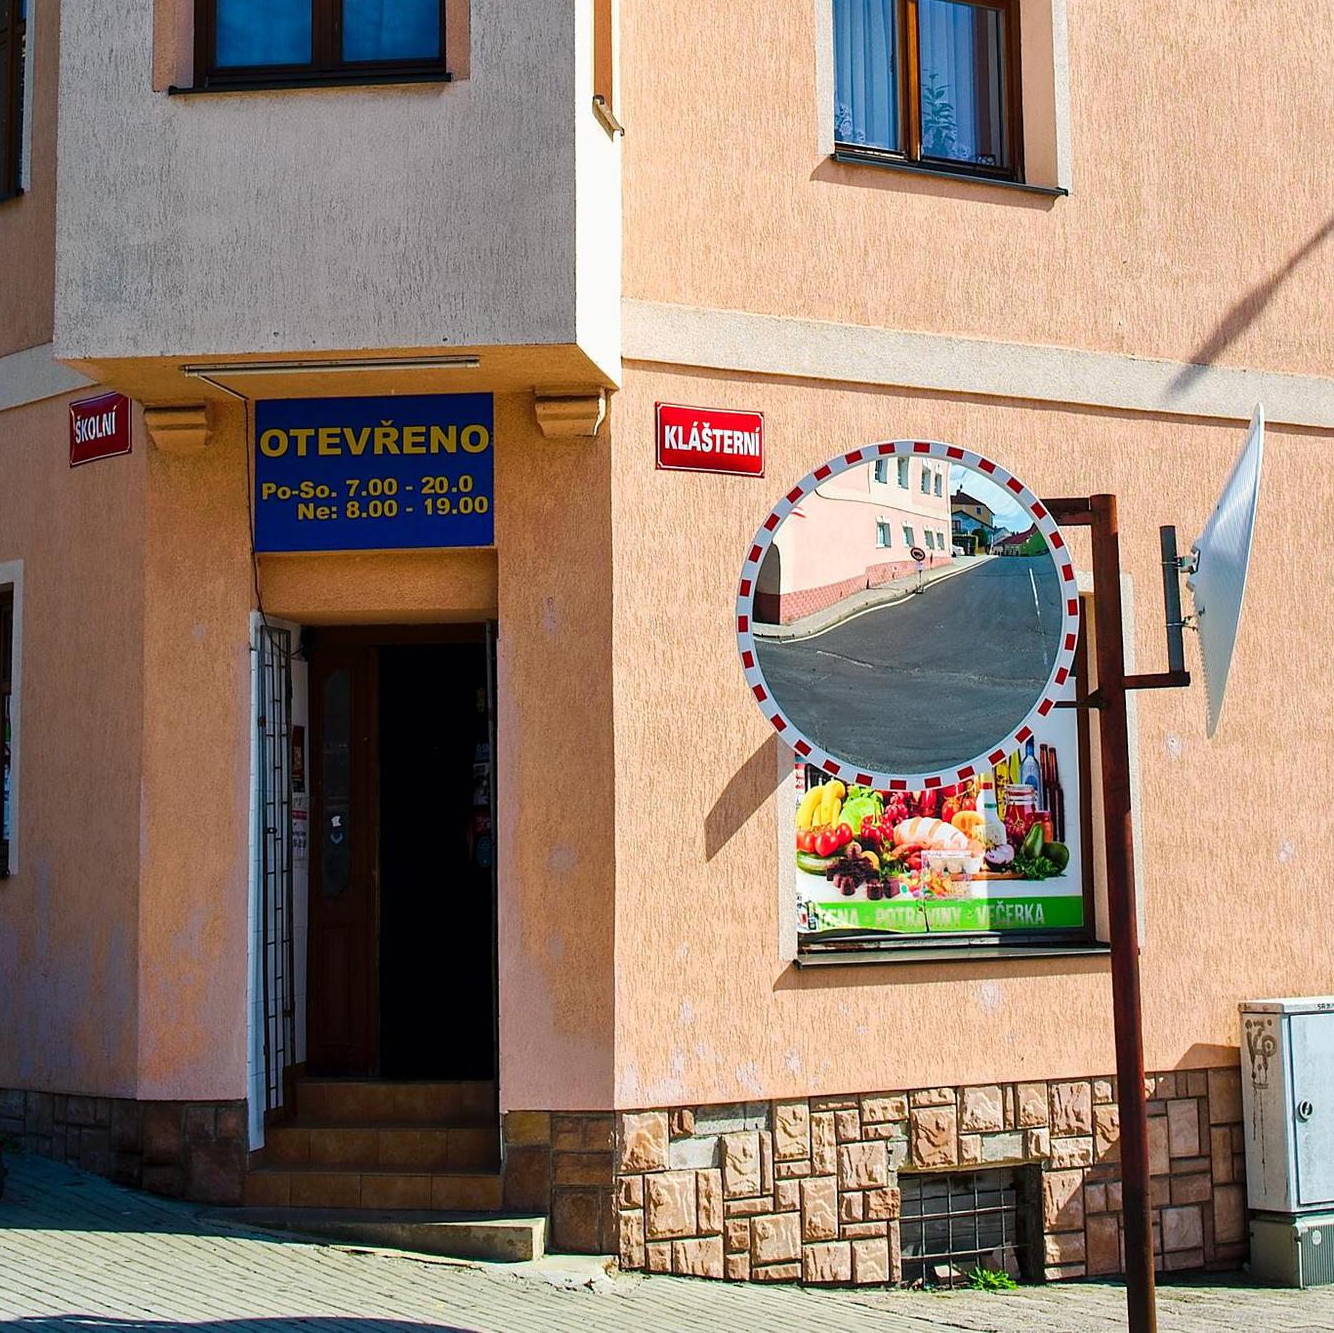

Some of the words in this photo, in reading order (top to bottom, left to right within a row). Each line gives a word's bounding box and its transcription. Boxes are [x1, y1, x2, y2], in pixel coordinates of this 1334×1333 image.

[75, 405, 117, 444] ŠKOLNÍ
[260, 420, 490, 457] OTEVŘENO
[664, 421, 760, 457] KLÁŠTERNÍ
[262, 480, 338, 500] Po-So.
[346, 478, 398, 497] 7.00
[421, 475, 473, 494] 20.0
[297, 503, 337, 520] Ne:
[346, 499, 398, 518] 8.00
[424, 496, 488, 515] 19.00
